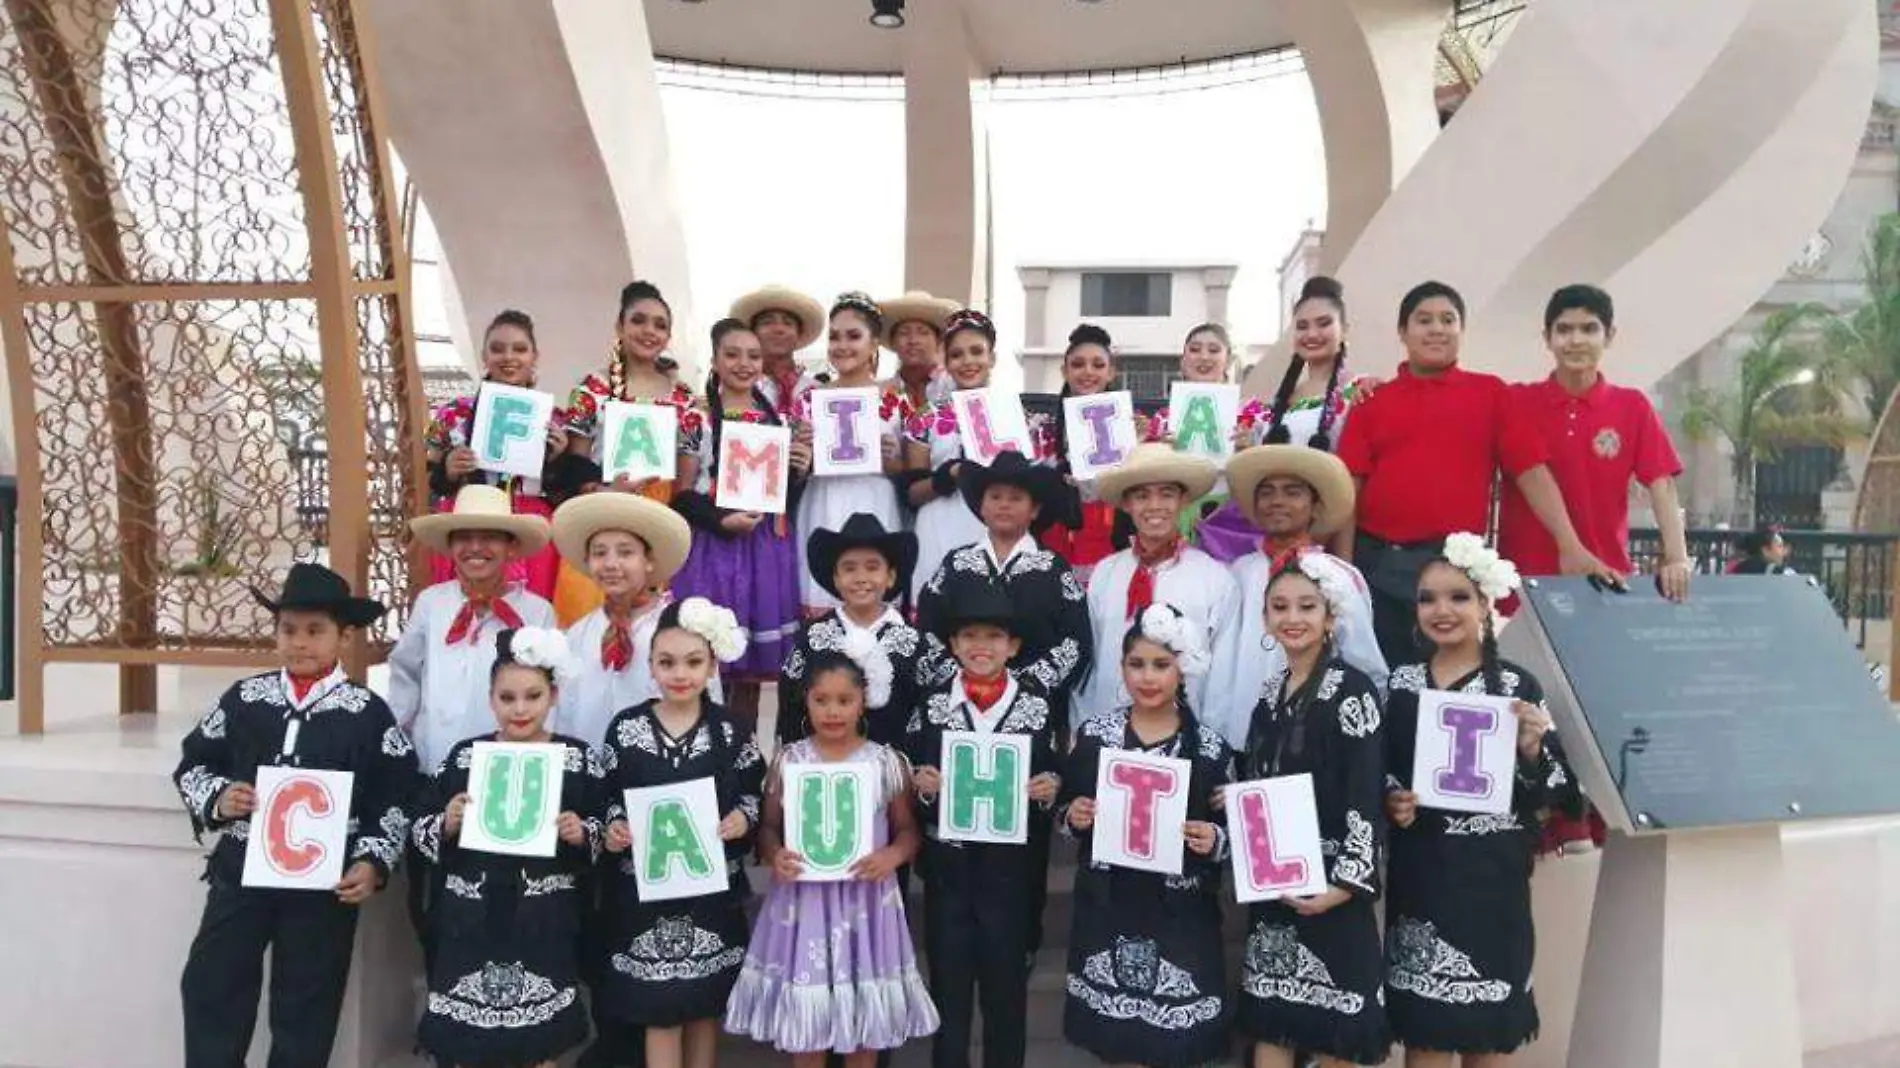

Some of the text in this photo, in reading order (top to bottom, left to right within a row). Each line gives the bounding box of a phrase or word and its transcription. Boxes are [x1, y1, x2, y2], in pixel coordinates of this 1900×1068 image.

[488, 395, 534, 460] F
[613, 413, 663, 467] A
[827, 400, 868, 462] I
[967, 398, 1018, 457] L
[1080, 400, 1124, 467] I
[1174, 395, 1223, 453] A
[724, 436, 782, 501] M
[947, 740, 1020, 837] H
[1437, 703, 1498, 797] I
[264, 775, 332, 876] C
[480, 750, 551, 845] U
[643, 797, 716, 885] A
[797, 771, 863, 871] U
[1109, 759, 1177, 858] T
[1236, 788, 1309, 890] L
